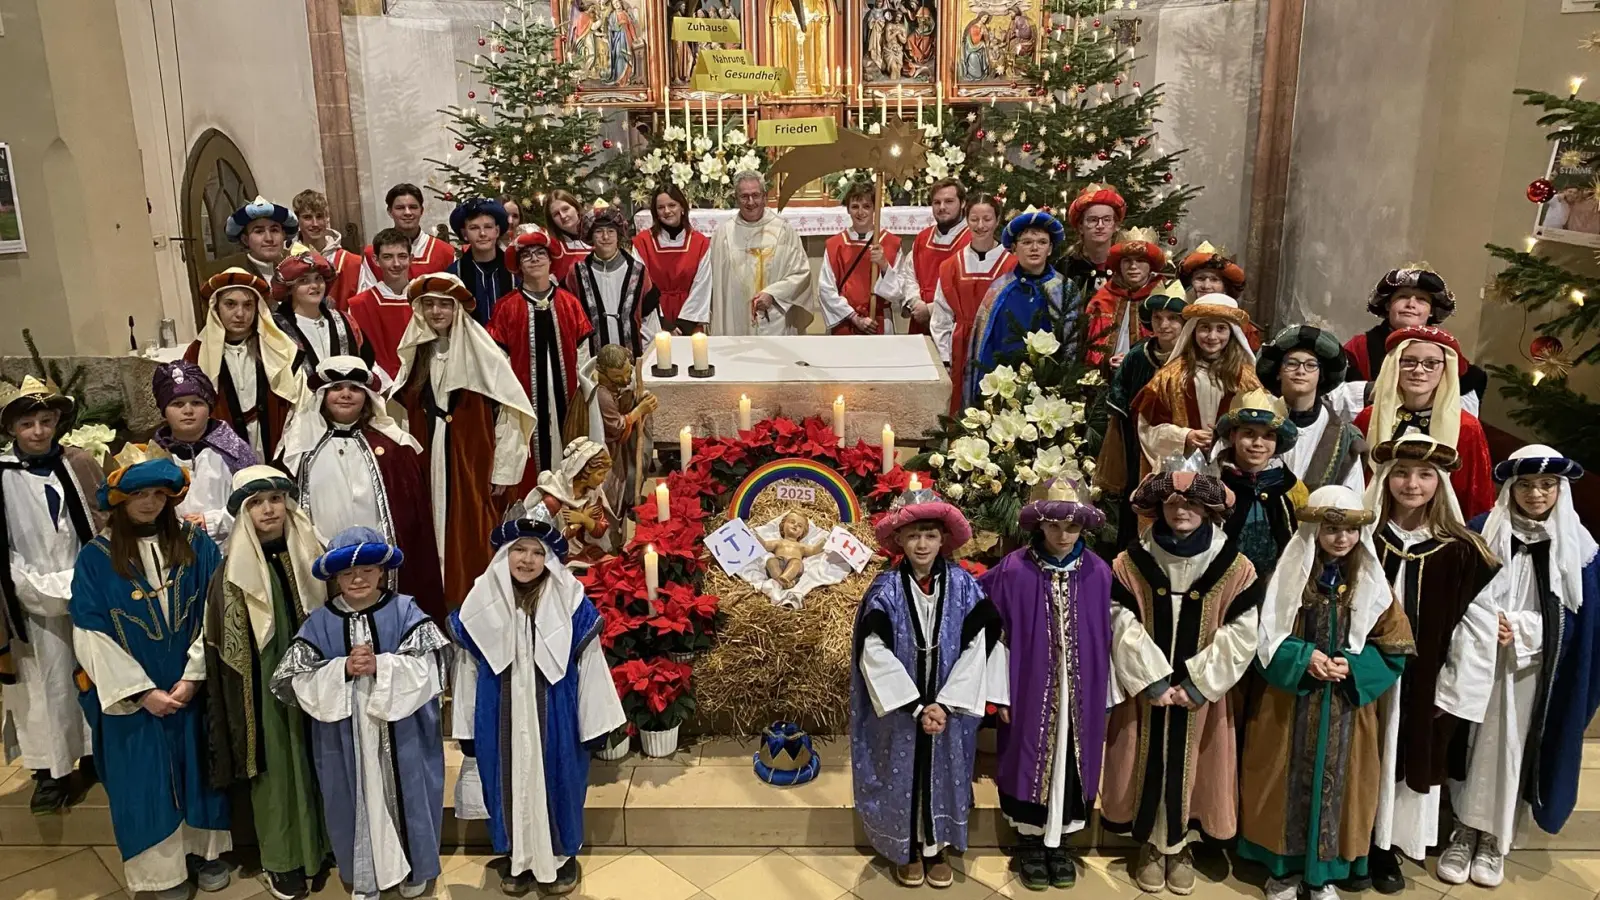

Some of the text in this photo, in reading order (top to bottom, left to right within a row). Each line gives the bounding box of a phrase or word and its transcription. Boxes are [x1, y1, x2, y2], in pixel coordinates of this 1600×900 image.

[687, 22, 728, 32] Zuhause
[712, 55, 746, 65] Nahrung
[775, 123, 818, 134] Frieden
[780, 487, 812, 500] 2025
[723, 533, 741, 552] T
